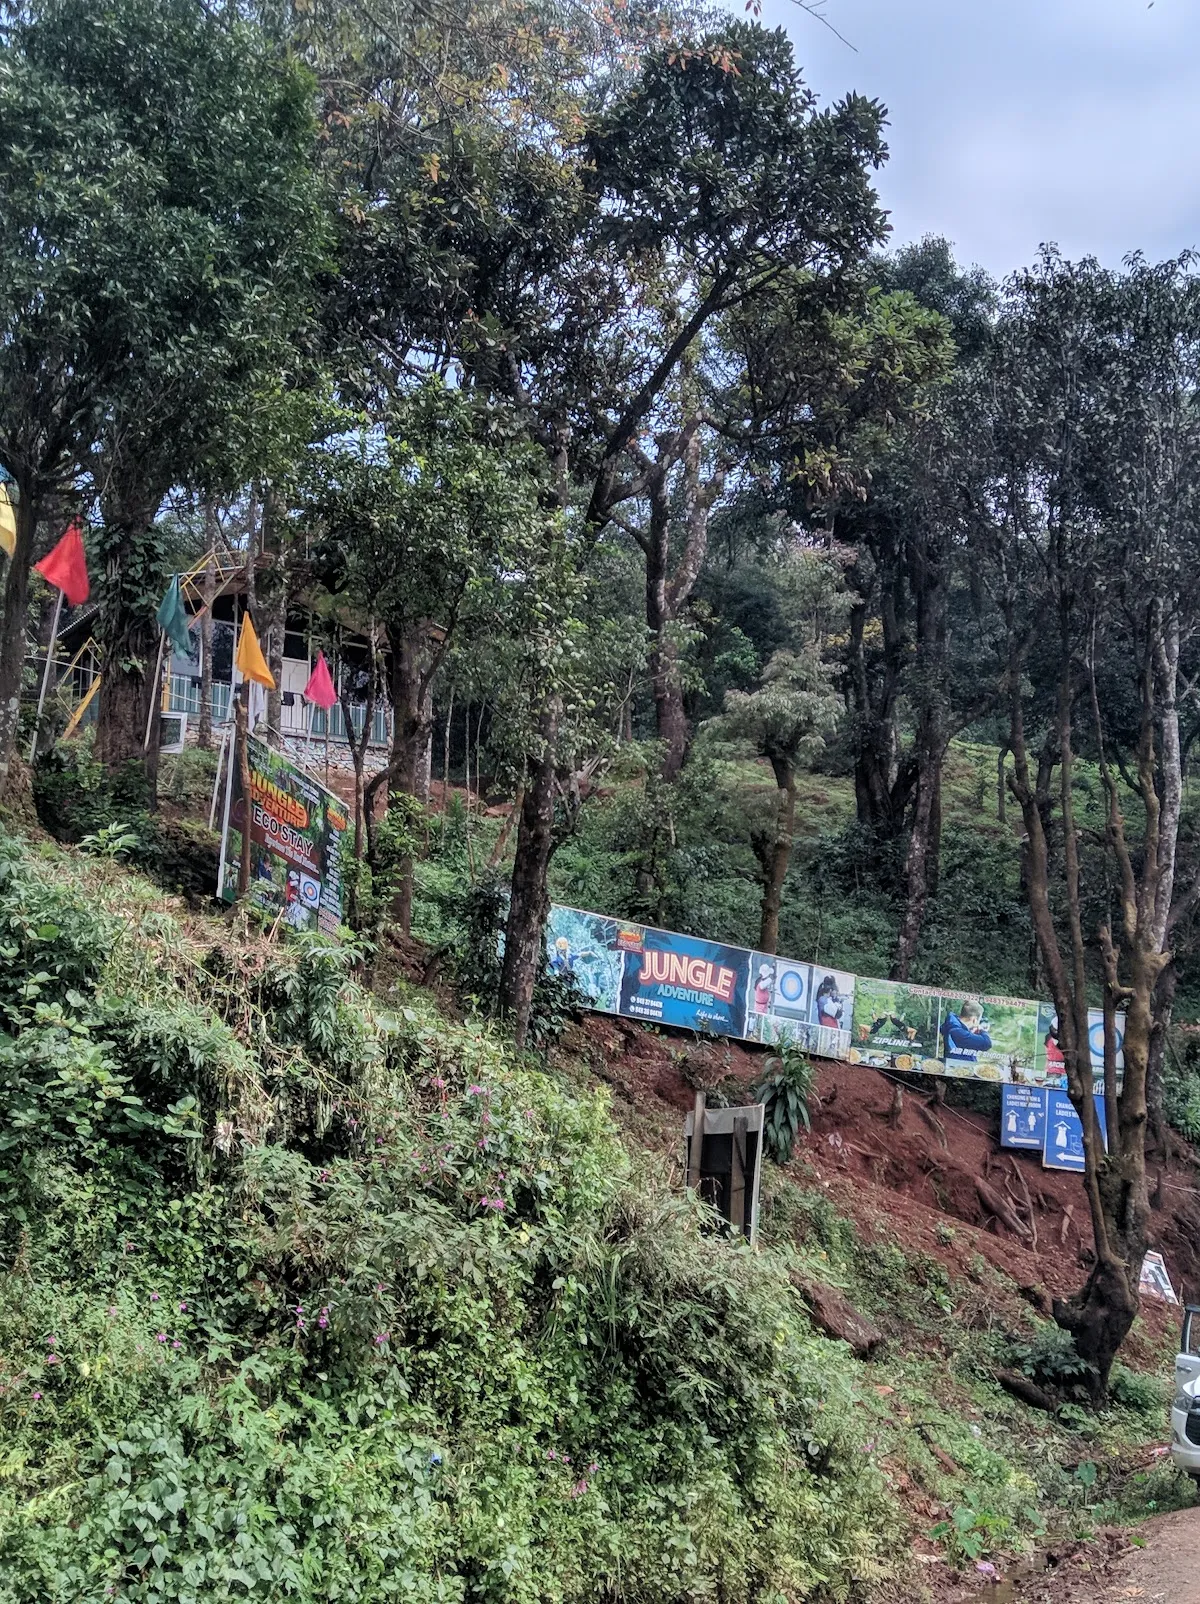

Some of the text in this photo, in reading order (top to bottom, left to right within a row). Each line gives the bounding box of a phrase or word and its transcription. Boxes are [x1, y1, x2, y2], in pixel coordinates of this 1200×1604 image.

[253, 804, 279, 836] ECO
[281, 824, 314, 856] STAY
[640, 951, 734, 998] JUNGLE
[657, 984, 714, 1006] ADVENTURE
[872, 1036, 910, 1047] ZIPLINE
[950, 1047, 962, 1055] AIR
[963, 1048, 981, 1057] RIFLE
